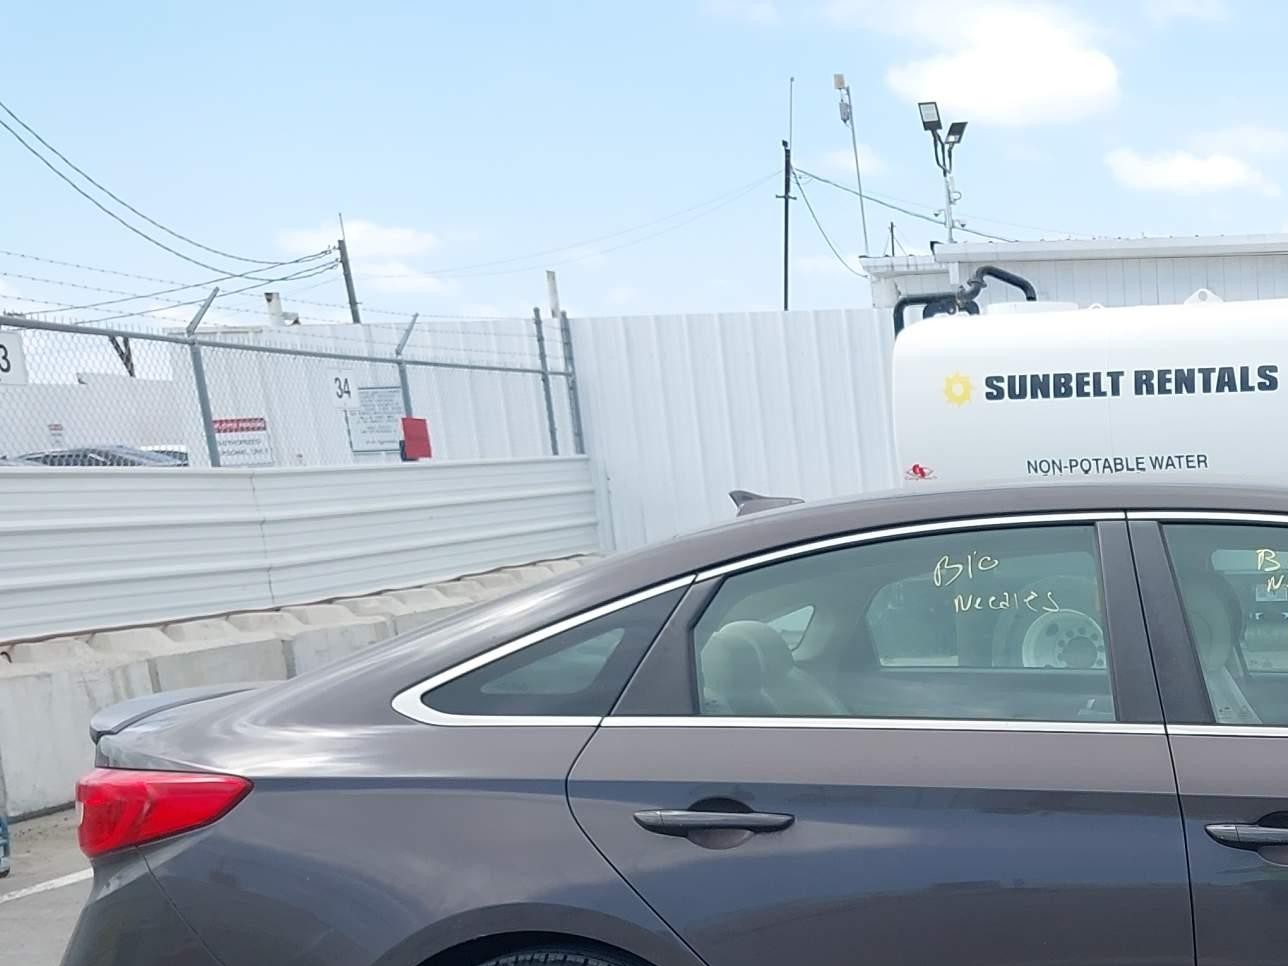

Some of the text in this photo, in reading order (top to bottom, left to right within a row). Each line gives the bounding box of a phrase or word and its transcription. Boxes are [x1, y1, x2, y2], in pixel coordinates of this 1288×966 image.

[334, 377, 351, 399] 34
[985, 364, 1279, 401] SUNBELT RENTALS
[1027, 454, 1208, 475] NON-POTABLE WATER
